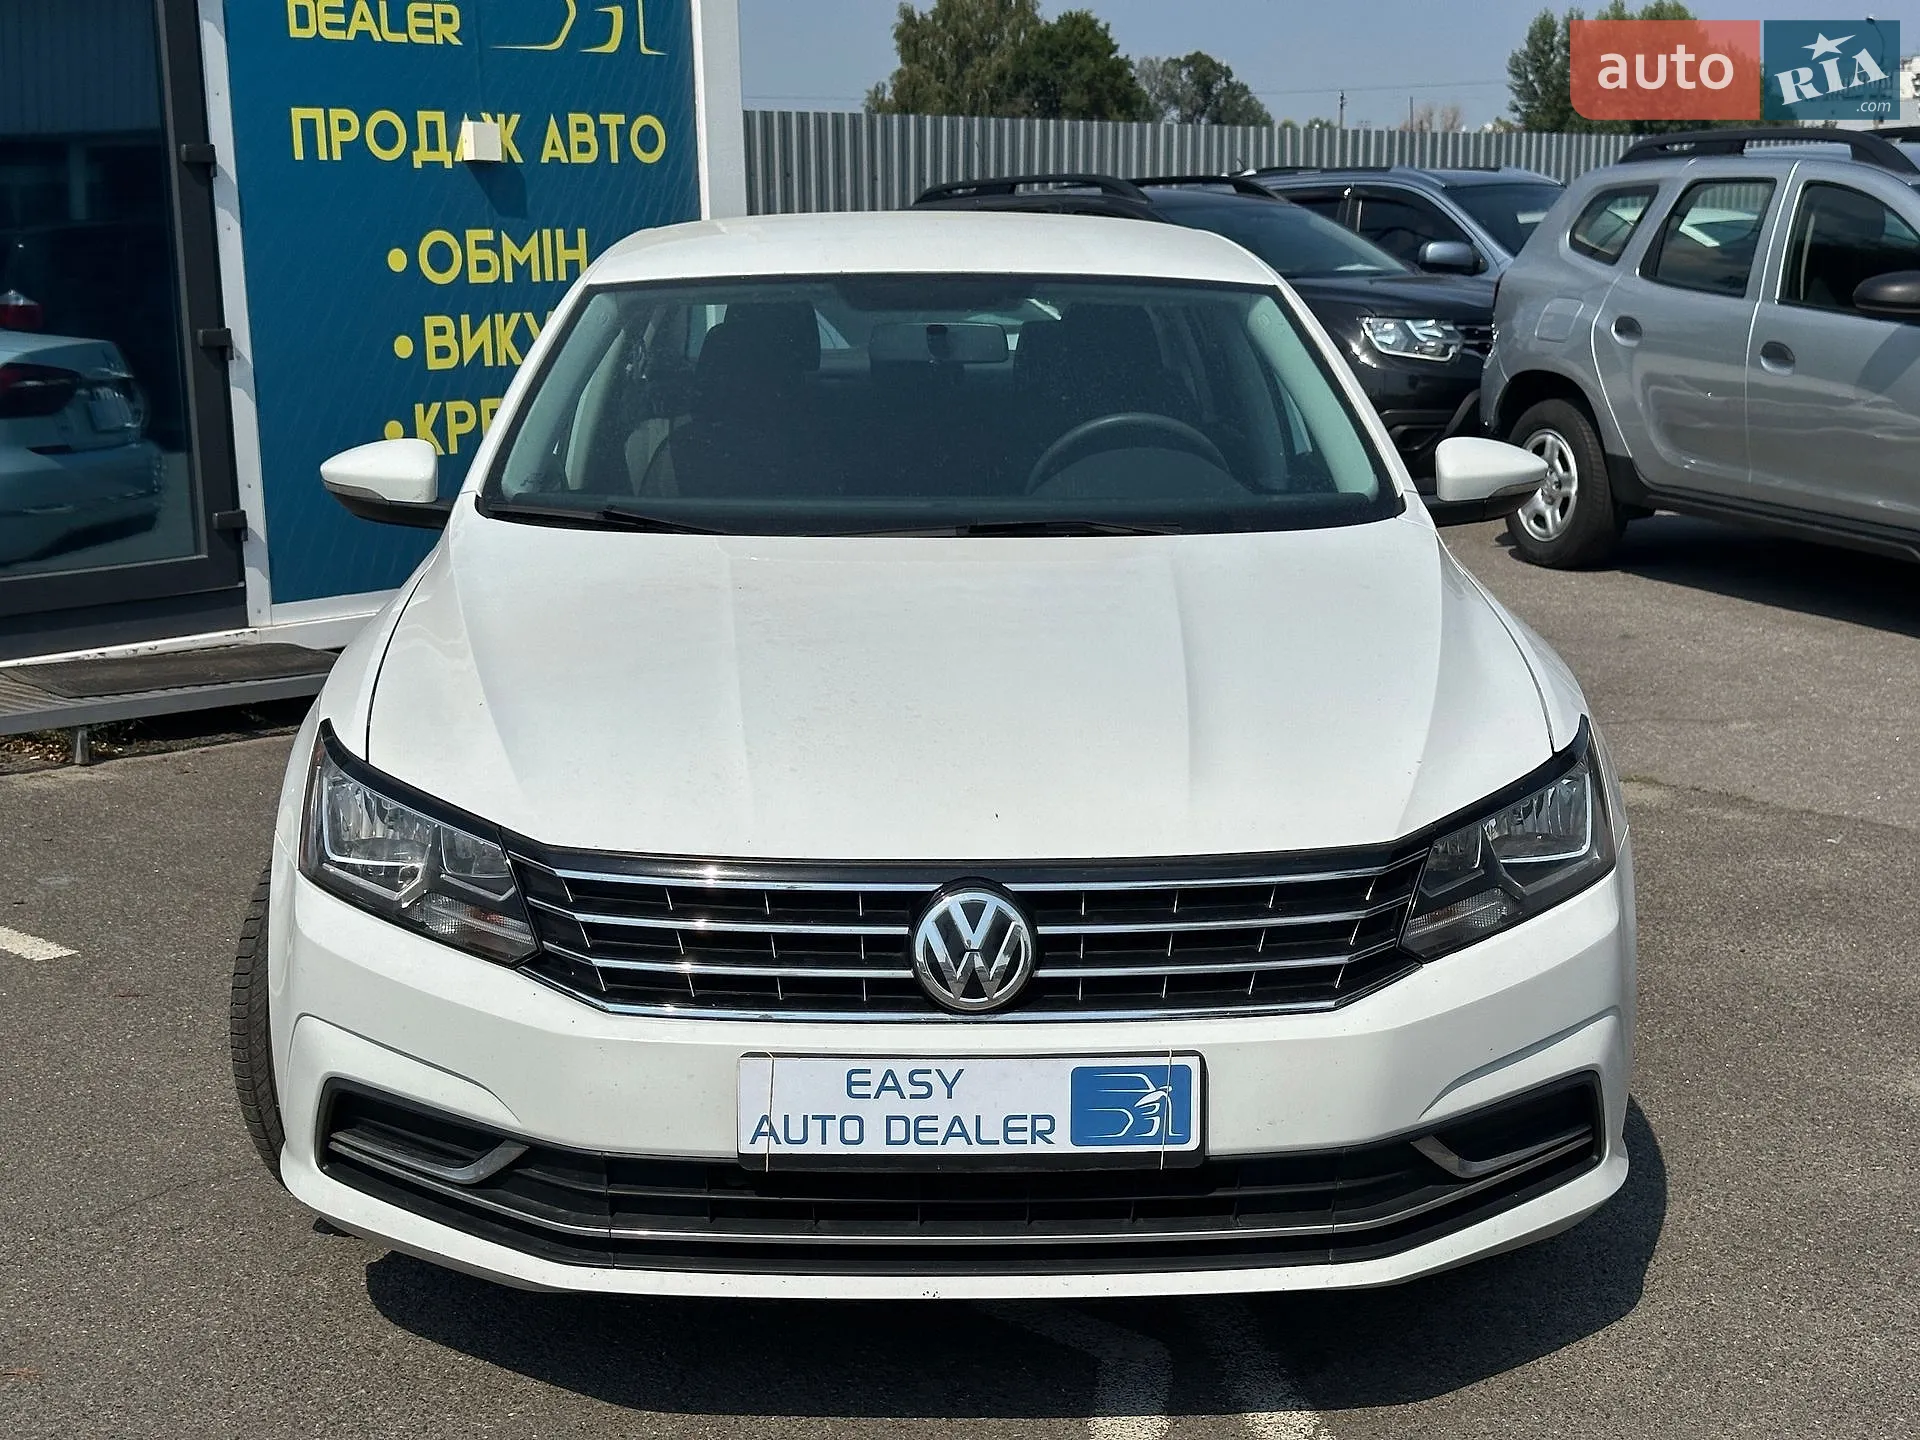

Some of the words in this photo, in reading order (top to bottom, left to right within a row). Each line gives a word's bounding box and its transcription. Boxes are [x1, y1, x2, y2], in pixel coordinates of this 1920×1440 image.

[288, 0, 463, 45] DEALER
[541, 114, 666, 164] АВТО
[418, 228, 588, 285] ОБМІН
[846, 1069, 964, 1100] EASY
[750, 1115, 864, 1146] AUTO
[886, 1115, 1056, 1146] DEALER
